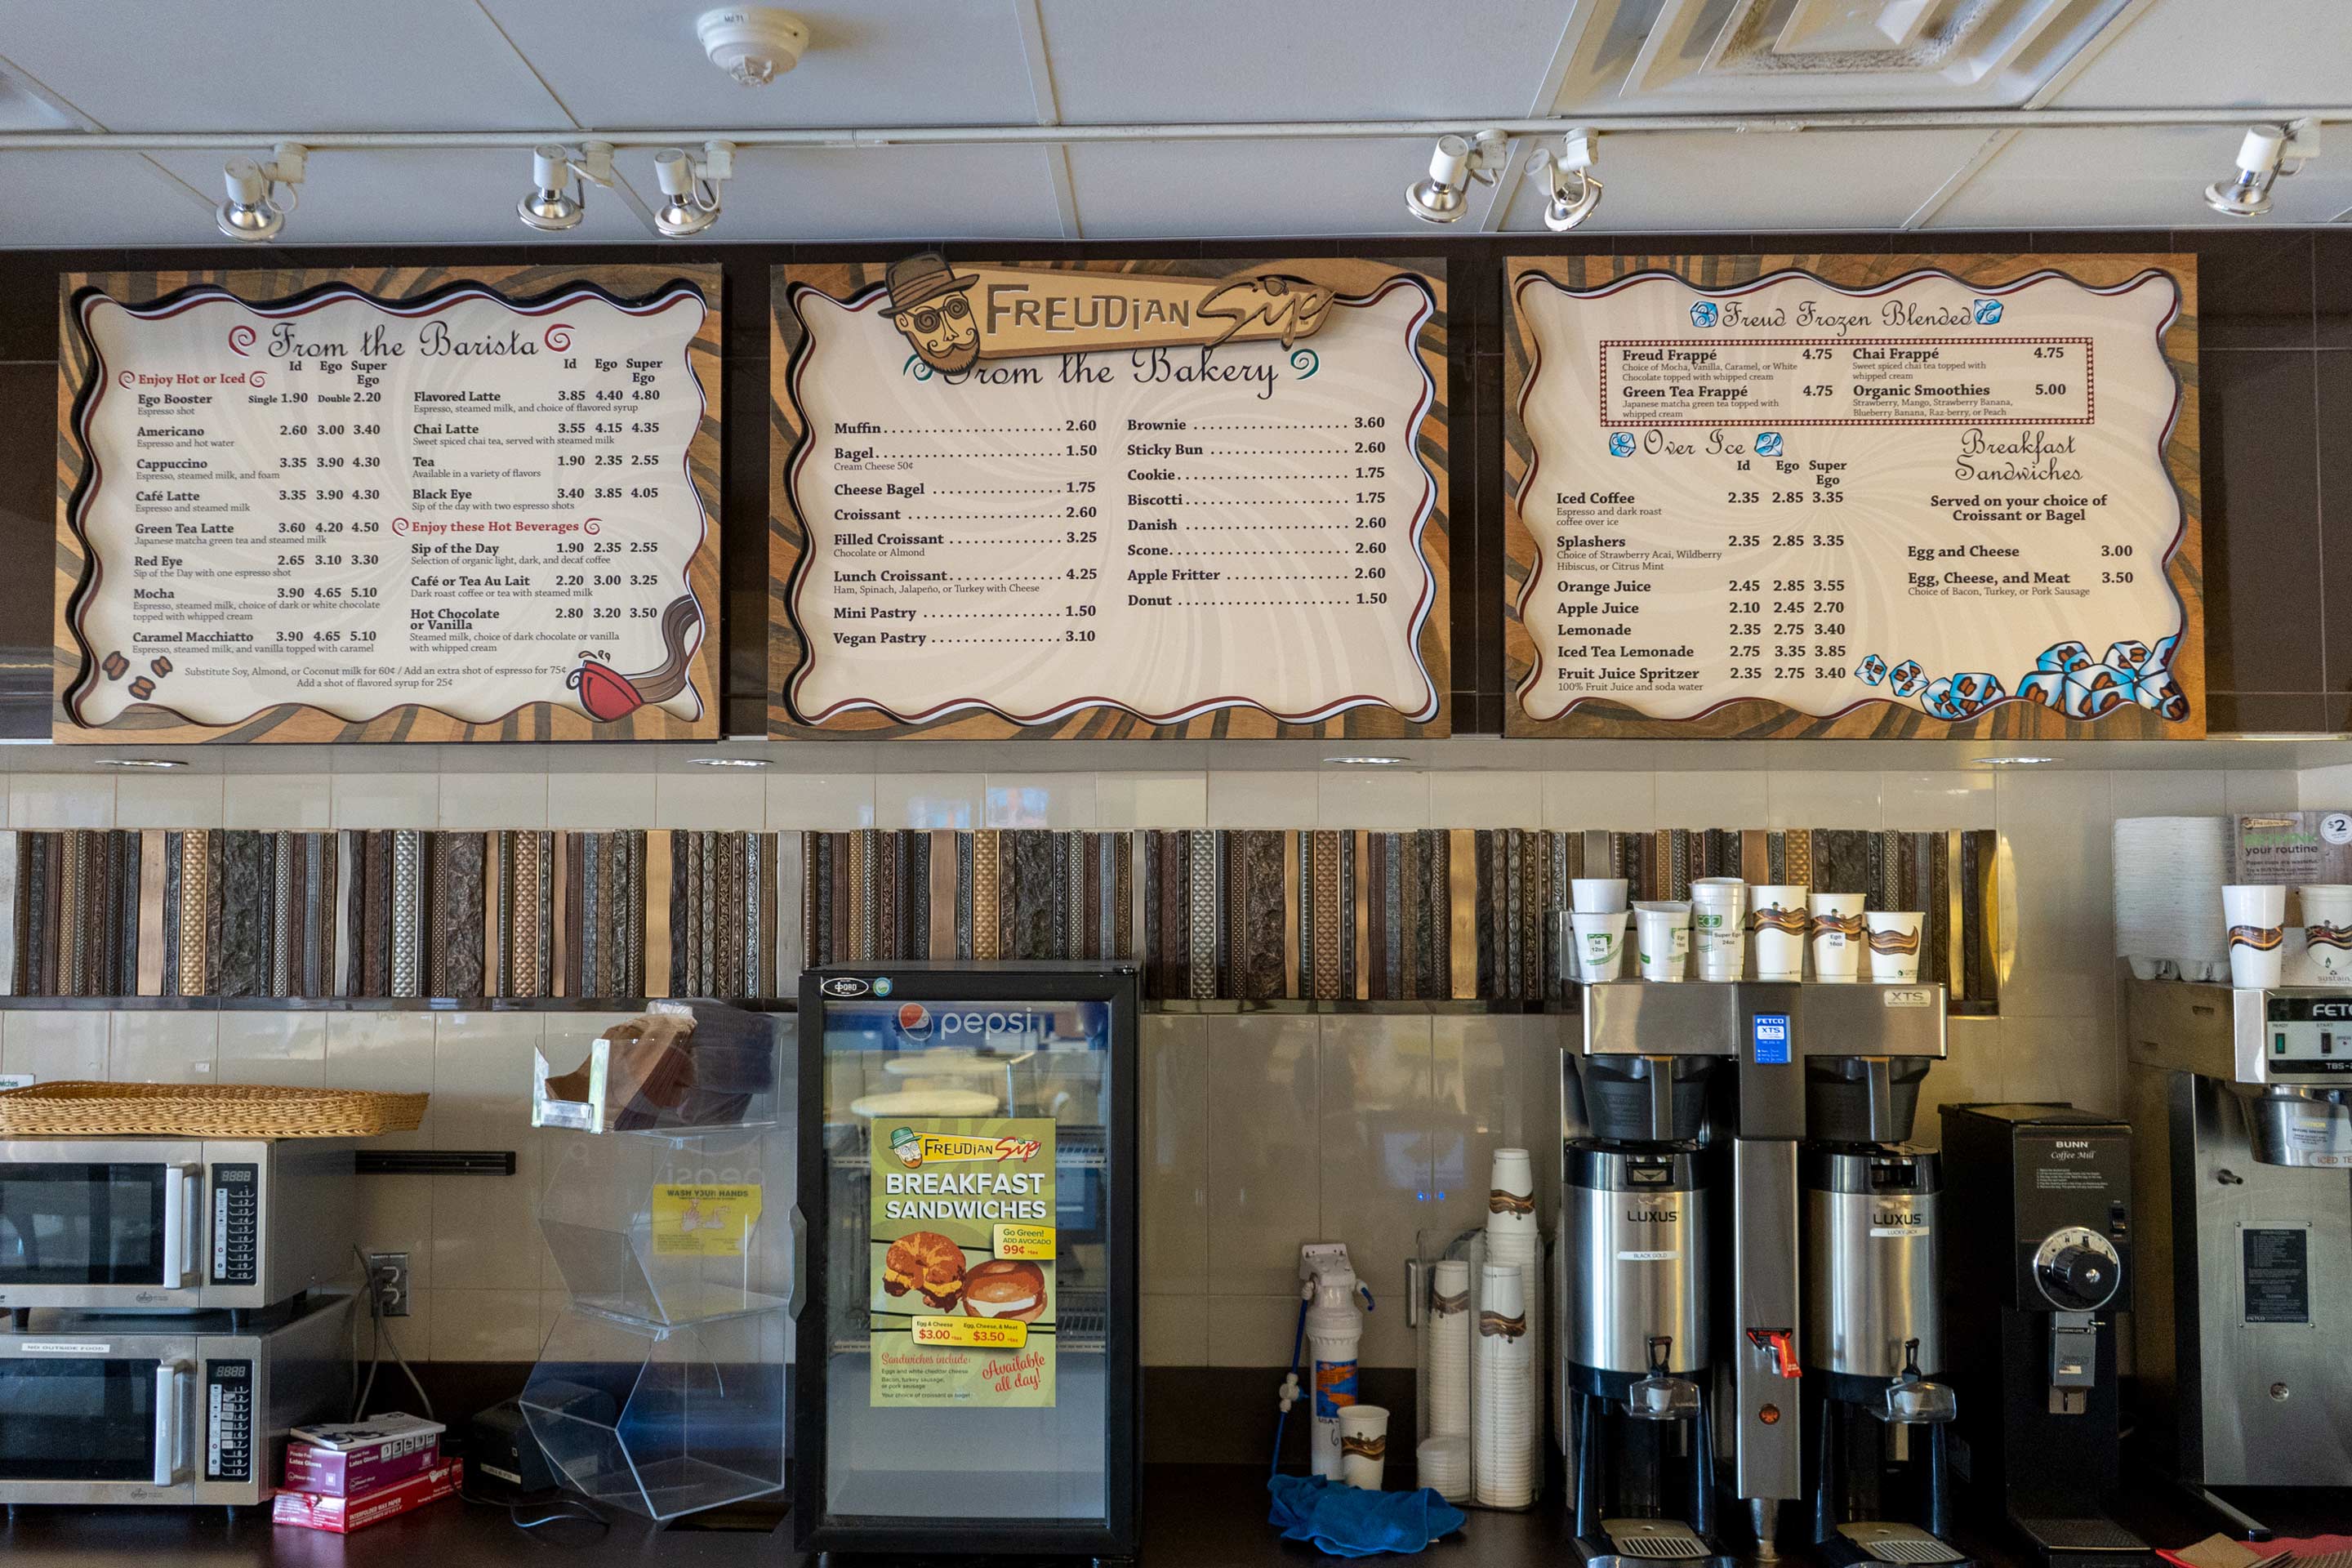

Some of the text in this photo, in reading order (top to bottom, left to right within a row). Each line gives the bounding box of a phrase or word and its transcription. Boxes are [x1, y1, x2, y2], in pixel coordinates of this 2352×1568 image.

[1196, 274, 1337, 350] Sip
[1722, 300, 1971, 336] Freud Frozen Blended
[268, 320, 538, 358] From the Barista
[1623, 349, 1832, 363] Freud Frappé 4.75
[289, 360, 387, 373] Id Ego Super
[138, 374, 173, 386] Enjoy
[176, 374, 199, 384] Hot
[220, 373, 245, 383] Iced
[1058, 353, 1115, 384] the
[1132, 348, 1279, 399] Bakery
[357, 375, 379, 387] Ego
[138, 392, 381, 406] Ego Booster Single 1.90 Double 2.20
[138, 407, 194, 417] Espresso shot
[835, 420, 1096, 434] Muffin 2.60
[1128, 417, 1385, 430] Brownie 3.60
[137, 425, 380, 436] Americano 2.60 3.00 3.40
[1644, 430, 1745, 455] Over Ice
[1957, 428, 2076, 466] Breakfast
[835, 445, 1097, 461] Bagel 1.50
[834, 461, 913, 470] Cream Cheese 50¢
[1955, 457, 2083, 480] Sandwiches
[412, 469, 451, 478] Available
[470, 470, 500, 479] variety
[501, 469, 511, 477] of
[513, 469, 541, 477] flavors
[835, 482, 1095, 497] Cheese Bagel 1.75
[1557, 492, 1843, 504] Iced Coffee 2.35 2.85 3.35
[412, 522, 579, 534] Enjoy these Hot Beverages
[412, 543, 499, 556] Sip of the Day
[1908, 546, 2132, 561] Egg and Cheese 3.00
[1558, 683, 1584, 691] 100%
[1586, 683, 1607, 691] Fruit
[1610, 683, 1633, 691] Juice
[1636, 682, 1653, 691] and
[1655, 682, 1676, 691] soda
[2328, 819, 2347, 831] $2
[2245, 844, 2318, 856] your routine
[1891, 991, 1923, 1001] XTS
[941, 1007, 1032, 1040] pepsi
[996, 1136, 1041, 1163] Sip
[2051, 1151, 2096, 1160] Coffee Mill
[2317, 1156, 2339, 1164] ICED
[885, 1174, 1045, 1196] BREAKFAST
[885, 1200, 1046, 1219] SANDWICHES
[1627, 1209, 1677, 1223] LUXUS
[1873, 1213, 1922, 1225] LUXUS
[1003, 1228, 1045, 1237] Go Green!
[1003, 1245, 1025, 1255] 99¢
[919, 1329, 950, 1340] $3.00
[973, 1330, 1005, 1342] $3.50
[881, 1352, 934, 1365] Sandwiches
[982, 1351, 1046, 1379] Available
[995, 1367, 1041, 1392] all day!
